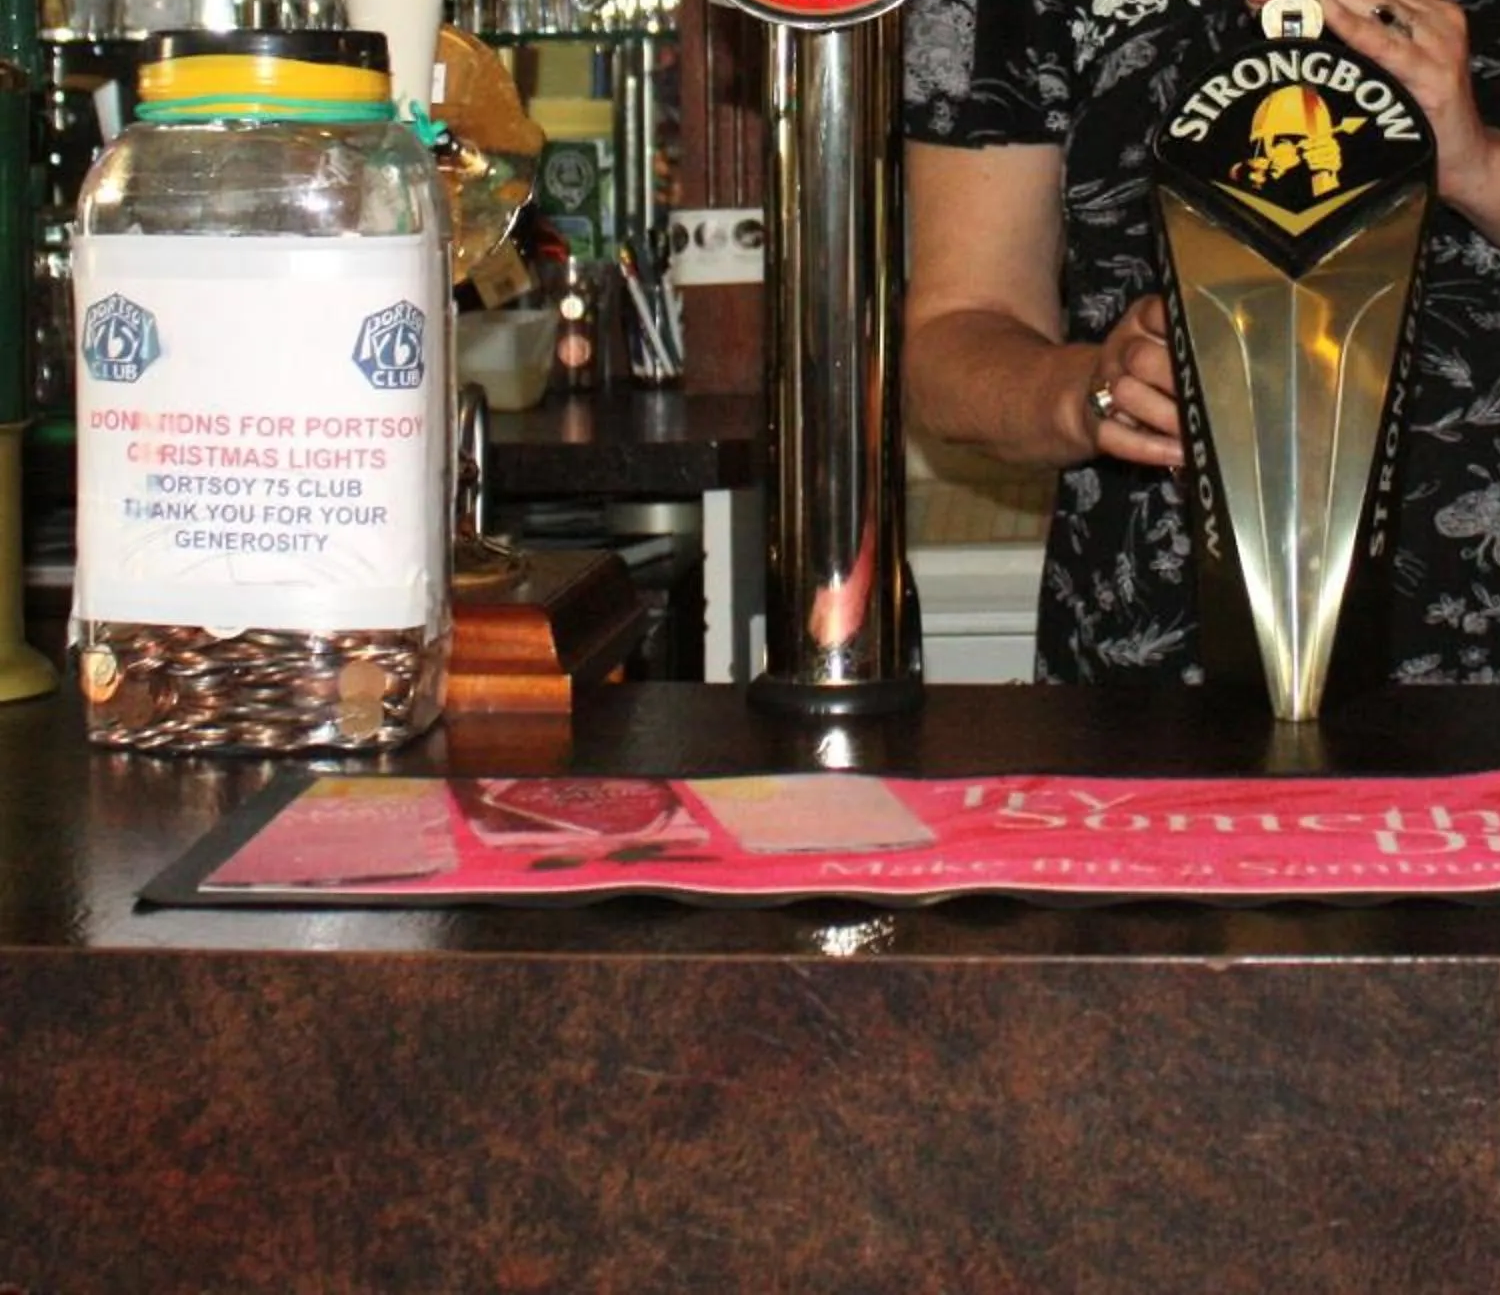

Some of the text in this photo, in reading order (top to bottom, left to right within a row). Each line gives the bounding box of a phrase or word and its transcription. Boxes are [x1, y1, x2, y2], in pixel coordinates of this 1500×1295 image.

[1169, 49, 1421, 143] STRONGBOW
[371, 370, 421, 387] CLUB
[240, 415, 294, 437] FOR
[305, 414, 423, 438] PORTSOY
[289, 448, 387, 469] LIGHTS
[264, 478, 289, 497] 75
[297, 478, 362, 498] CLUB
[207, 504, 256, 524] YOU
[263, 506, 312, 524] FOR
[322, 506, 387, 525] YOUR
[175, 529, 329, 552] GENEROSITY
